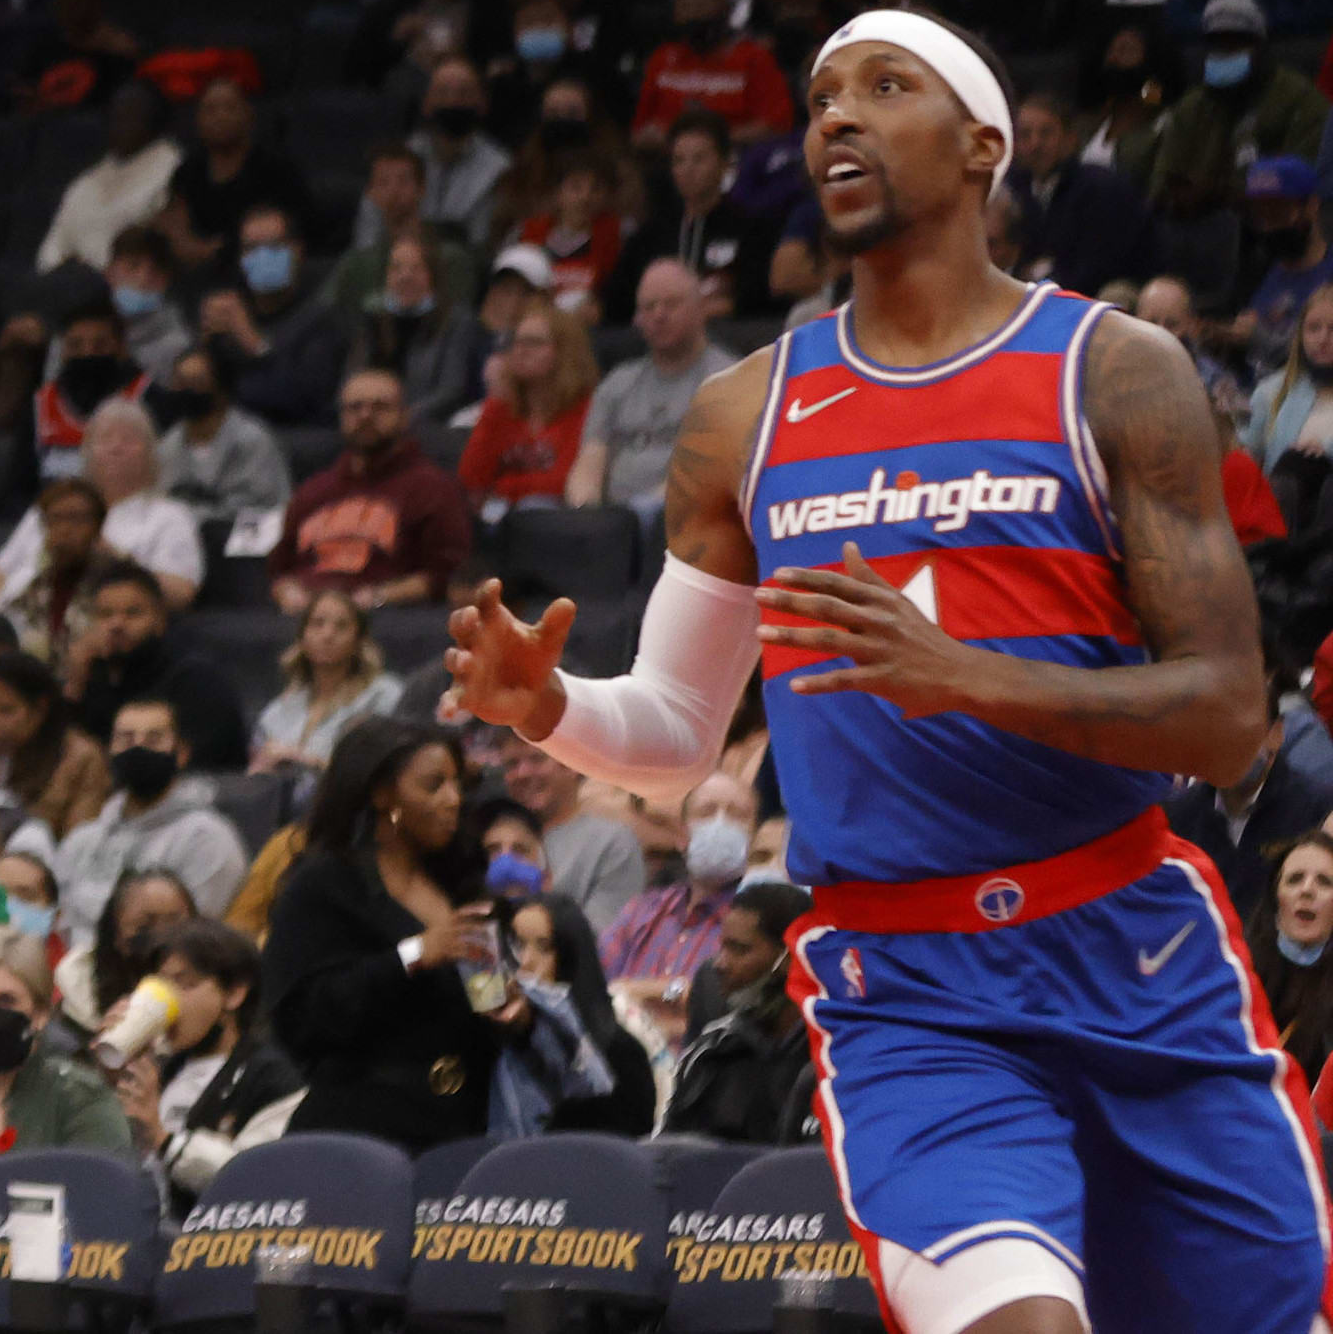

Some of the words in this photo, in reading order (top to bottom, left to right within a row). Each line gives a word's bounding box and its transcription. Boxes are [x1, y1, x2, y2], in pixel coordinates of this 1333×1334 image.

[181, 1198, 309, 1233] CAESARS
[443, 1194, 570, 1227] CAESARS
[696, 1212, 826, 1244] CAESARS
[425, 1223, 645, 1272] SPORTSBOOK
